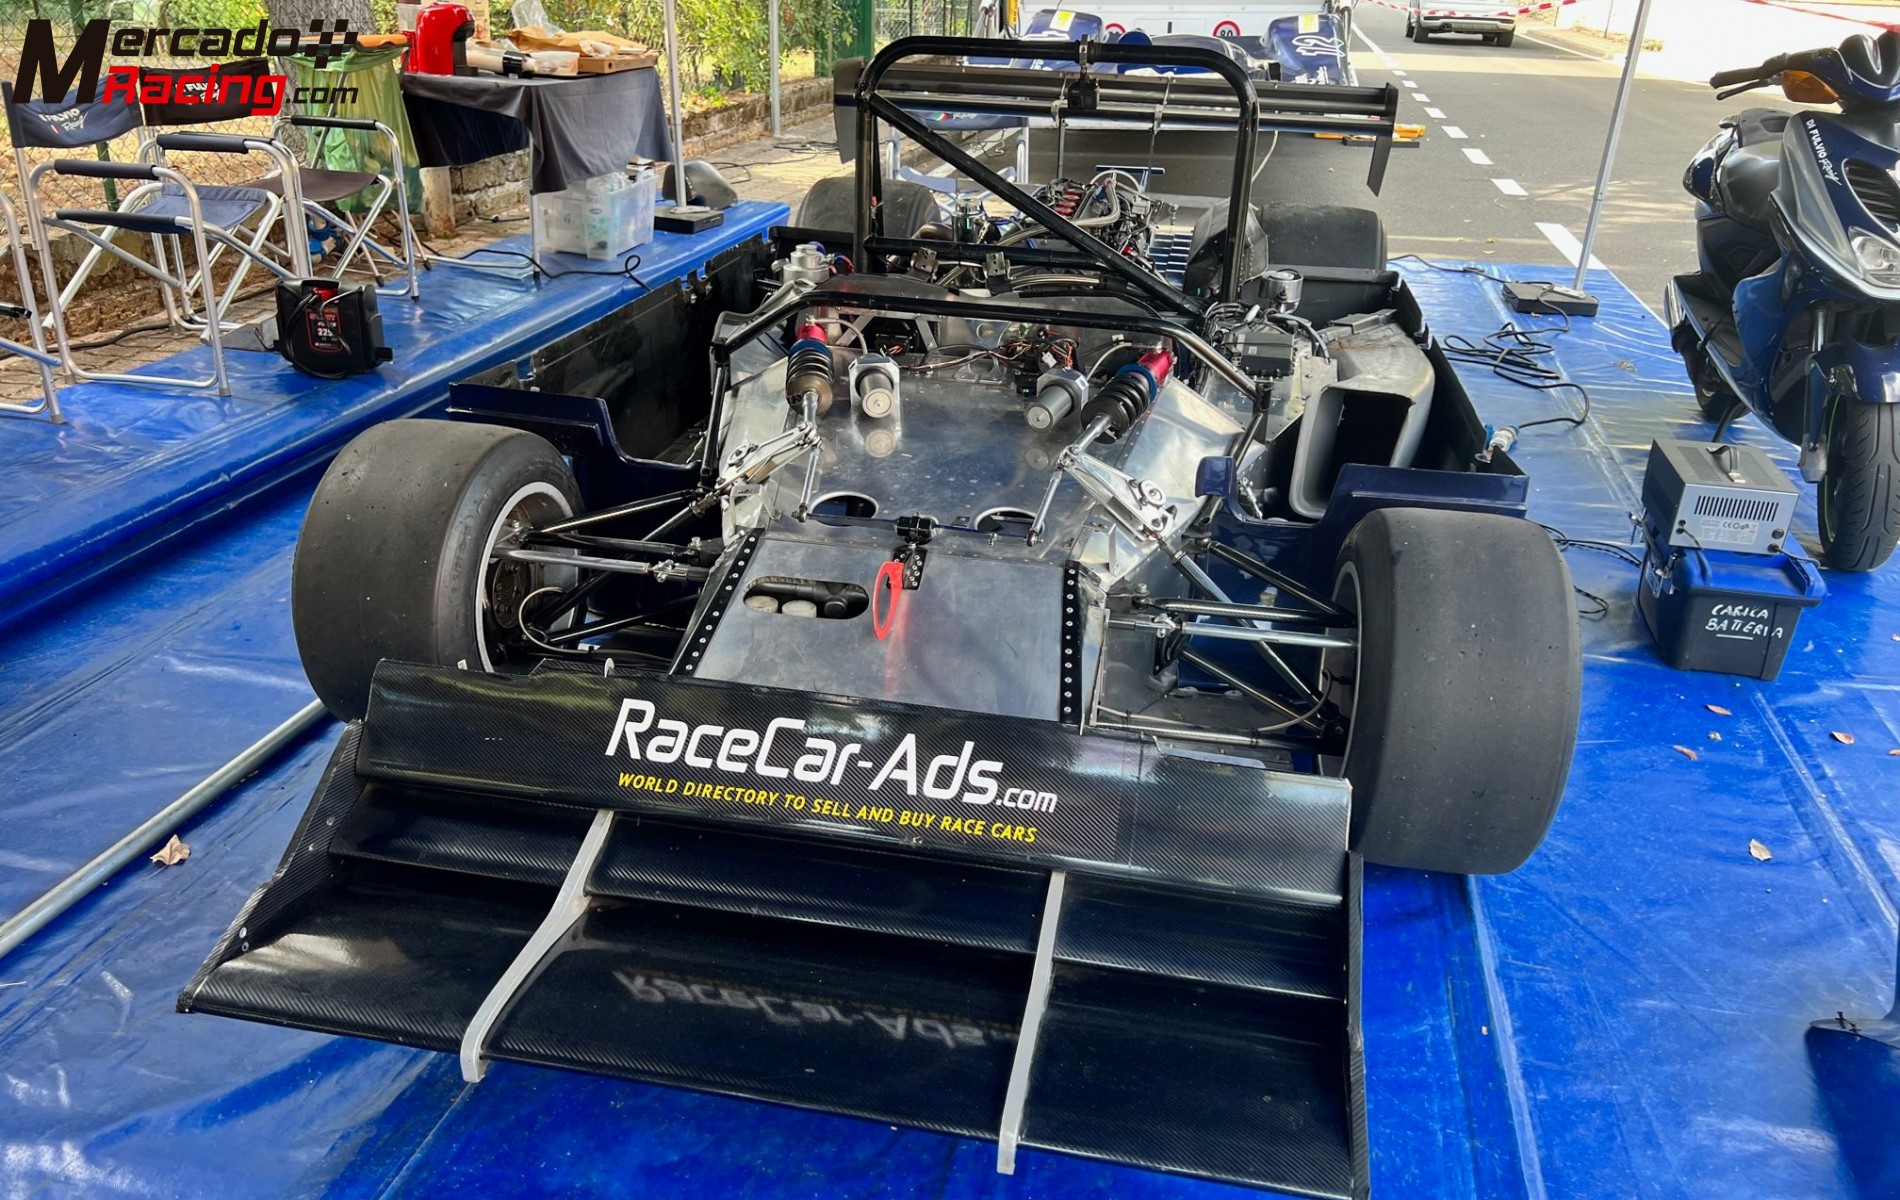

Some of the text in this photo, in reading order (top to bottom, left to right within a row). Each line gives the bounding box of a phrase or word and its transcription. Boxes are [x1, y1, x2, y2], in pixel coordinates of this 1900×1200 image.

[1806, 118, 1817, 129] DI
[1809, 128, 1828, 159] FULVIO
[1711, 604, 1769, 619] CARICA
[1705, 617, 1783, 638] BATTERIA
[605, 697, 1058, 814] RaceCar-Ads.com
[618, 772, 1039, 843] WORLD DIRECTORY TO SELL AND BUY RACE CARS
